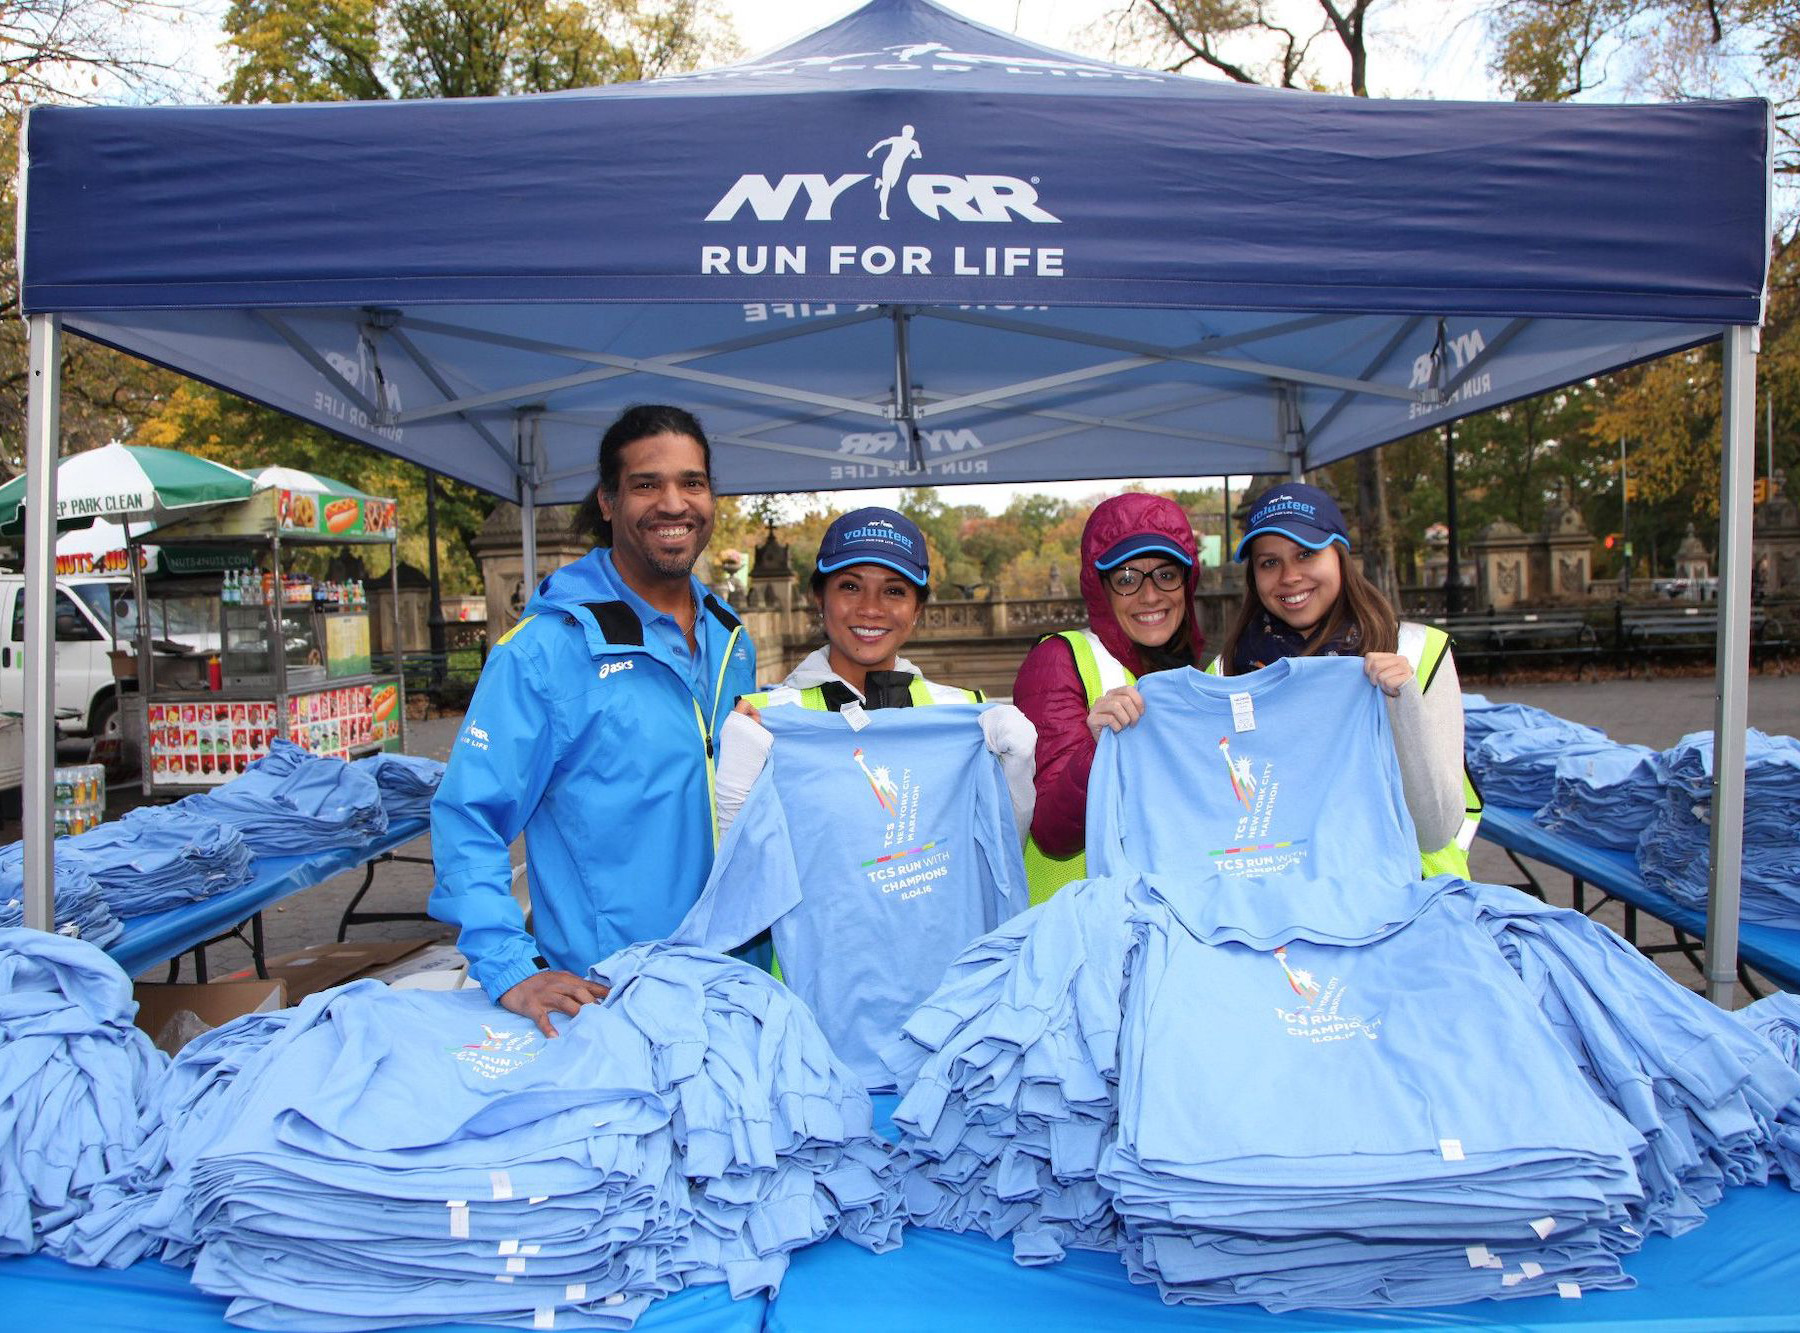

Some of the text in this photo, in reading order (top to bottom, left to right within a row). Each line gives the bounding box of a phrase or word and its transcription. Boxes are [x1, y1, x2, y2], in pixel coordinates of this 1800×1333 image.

[704, 174, 1063, 223] NYRR
[702, 246, 1064, 277] RUN FOR LIFE
[72, 499, 102, 514] PARK
[106, 493, 143, 510] CLEAN
[1251, 501, 1316, 523] volunteer
[844, 526, 913, 548] volunteer
[897, 768, 913, 844] NEW YORK CITY
[908, 784, 921, 841] MARATHON
[1248, 762, 1275, 838] NEW YORK CITY
[1260, 782, 1279, 837] MARATHON
[884, 822, 895, 848] TCS
[1234, 815, 1249, 840] TCS
[868, 851, 950, 883] TCS RUN WITH
[1214, 858, 1245, 871] TCS
[1246, 856, 1274, 867] RUN
[882, 866, 949, 893] CHAMPIONS
[1274, 1007, 1308, 1025] TCS
